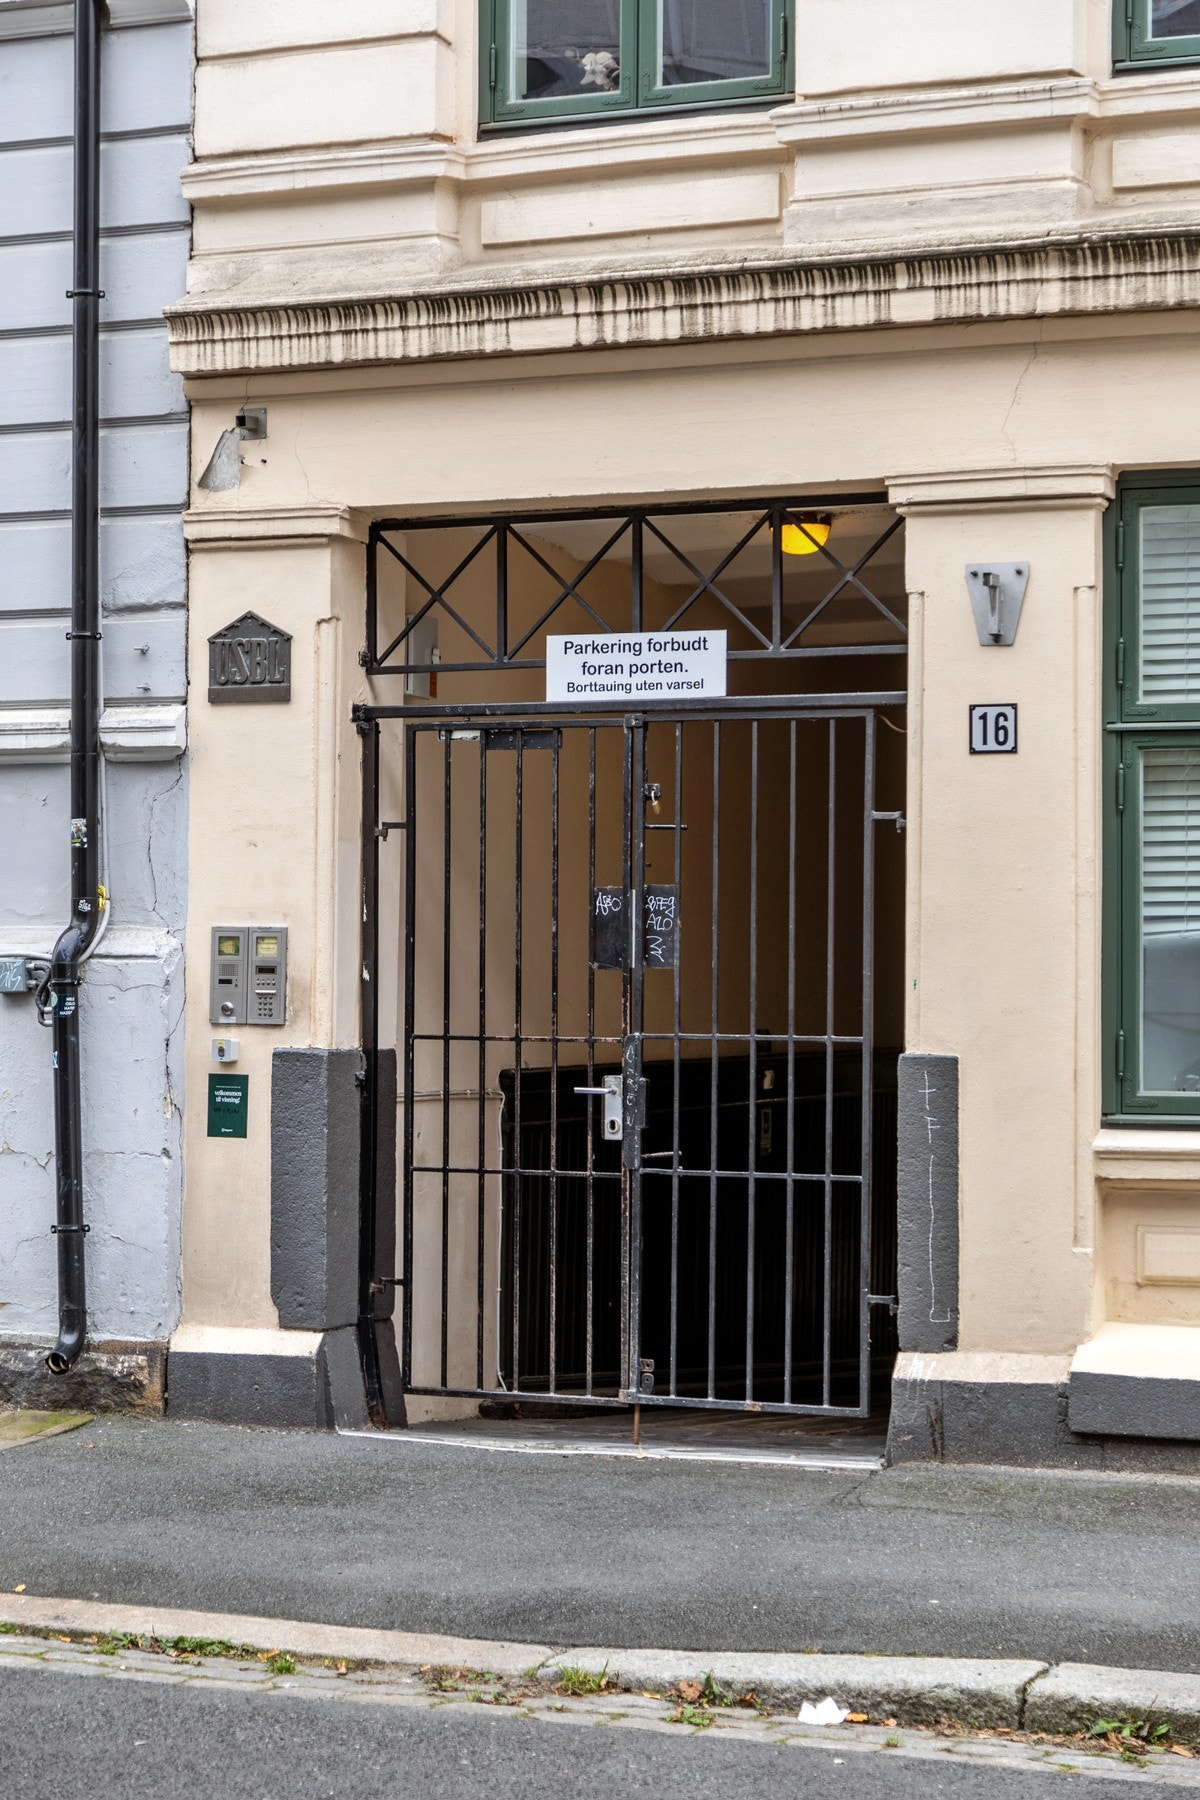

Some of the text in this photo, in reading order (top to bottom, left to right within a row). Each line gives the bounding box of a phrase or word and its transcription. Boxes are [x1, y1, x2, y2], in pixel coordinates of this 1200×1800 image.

[563, 636, 709, 656] Parkering forbudt
[213, 637, 286, 684] USBL
[581, 660, 689, 678] foran porten.
[566, 678, 704, 694] Borttauing uten varsel
[978, 711, 1009, 746] 16
